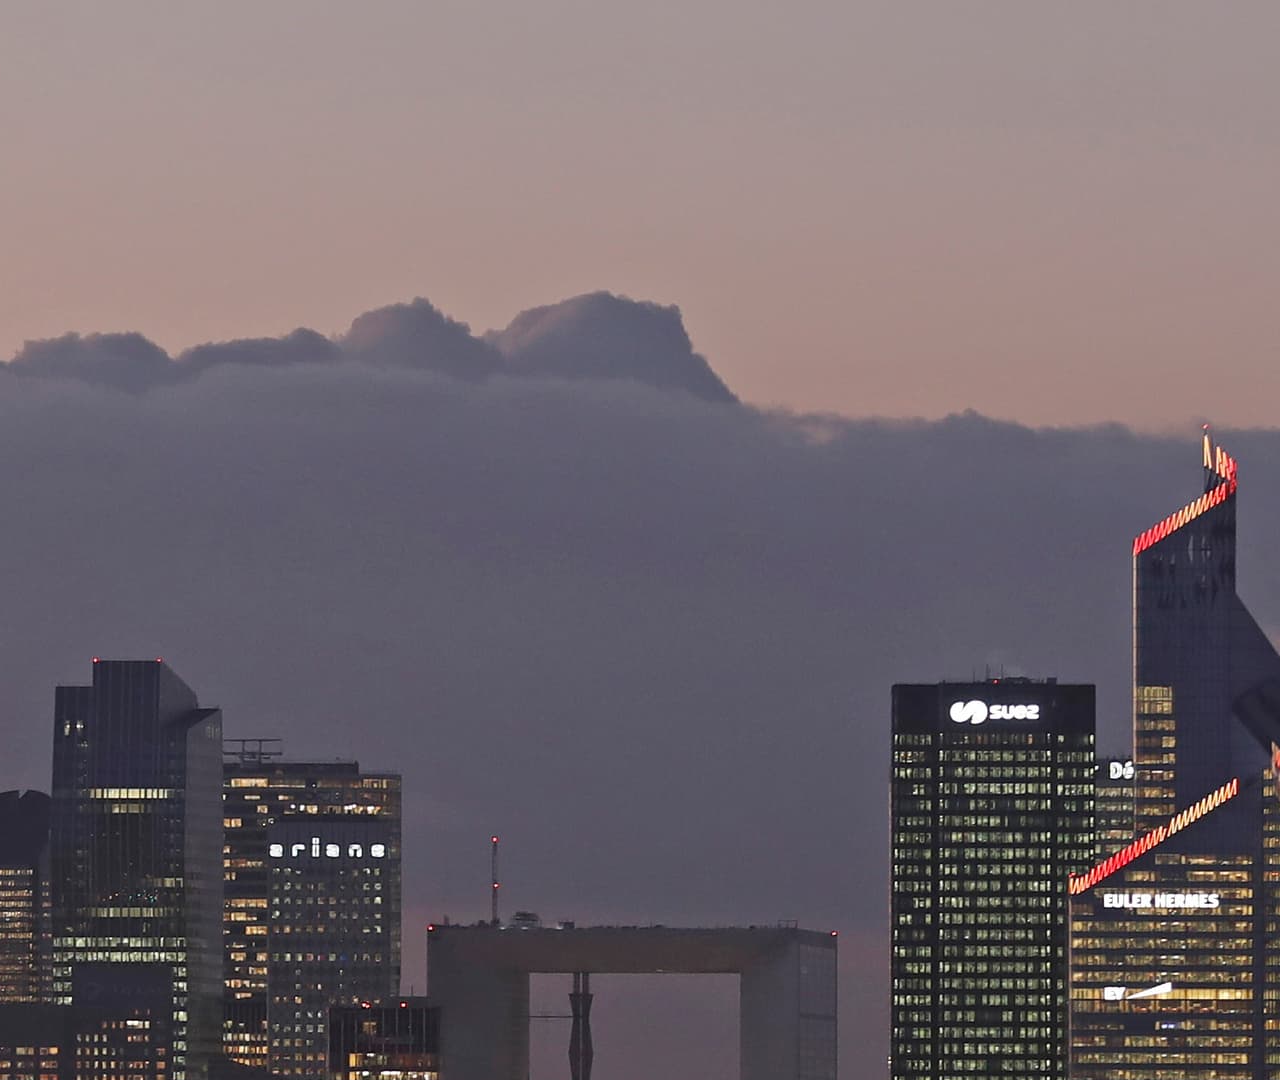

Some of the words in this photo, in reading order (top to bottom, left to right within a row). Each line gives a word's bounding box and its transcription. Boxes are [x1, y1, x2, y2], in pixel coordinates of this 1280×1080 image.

[268, 836, 386, 858] ariane
[1103, 893, 1152, 909] EULER
[1154, 893, 1220, 909] HERMES
